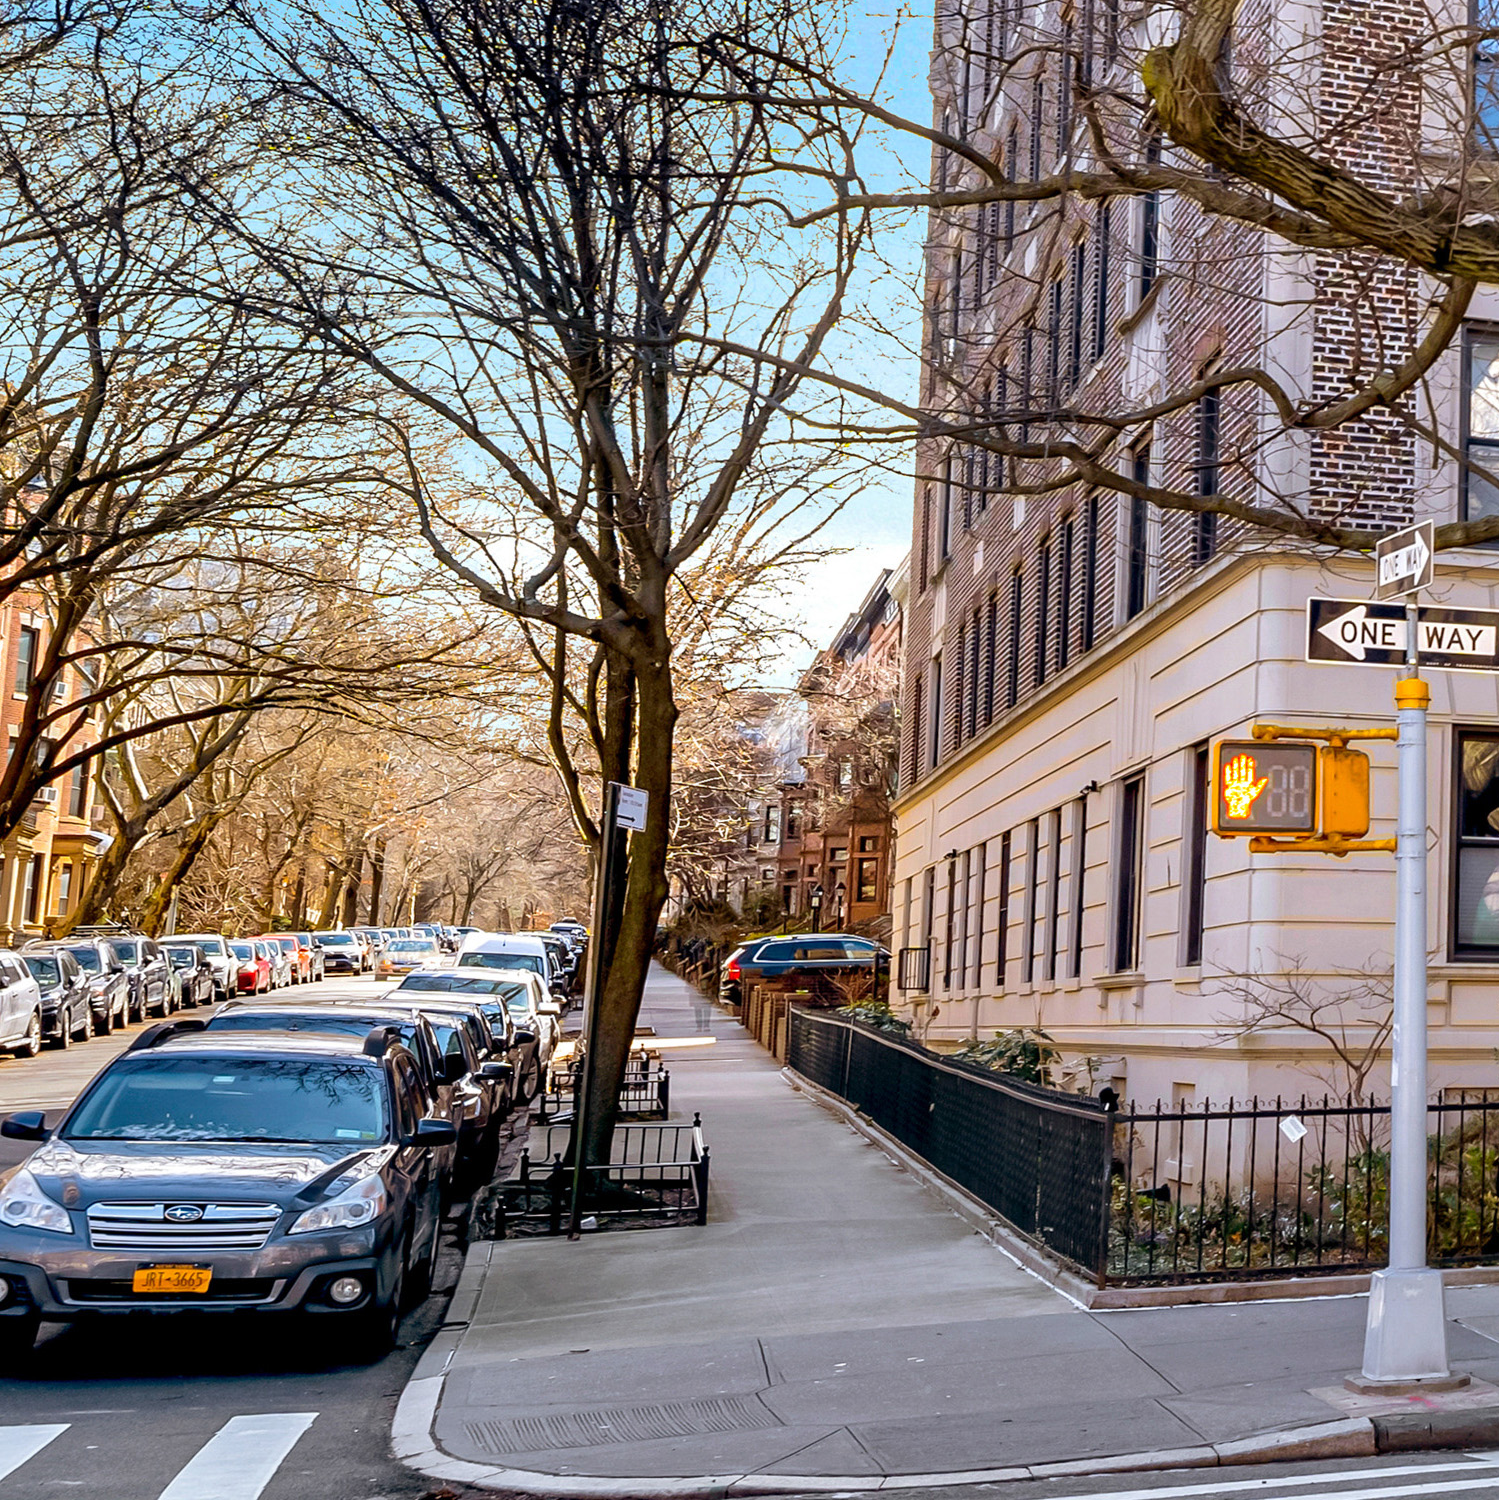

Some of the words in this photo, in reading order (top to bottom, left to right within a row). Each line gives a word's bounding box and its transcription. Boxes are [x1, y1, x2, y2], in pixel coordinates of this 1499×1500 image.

[1383, 554, 1399, 580] ONE
[1406, 545, 1424, 572] WAY
[1341, 620, 1396, 646] ONE
[1425, 625, 1484, 651] WAY
